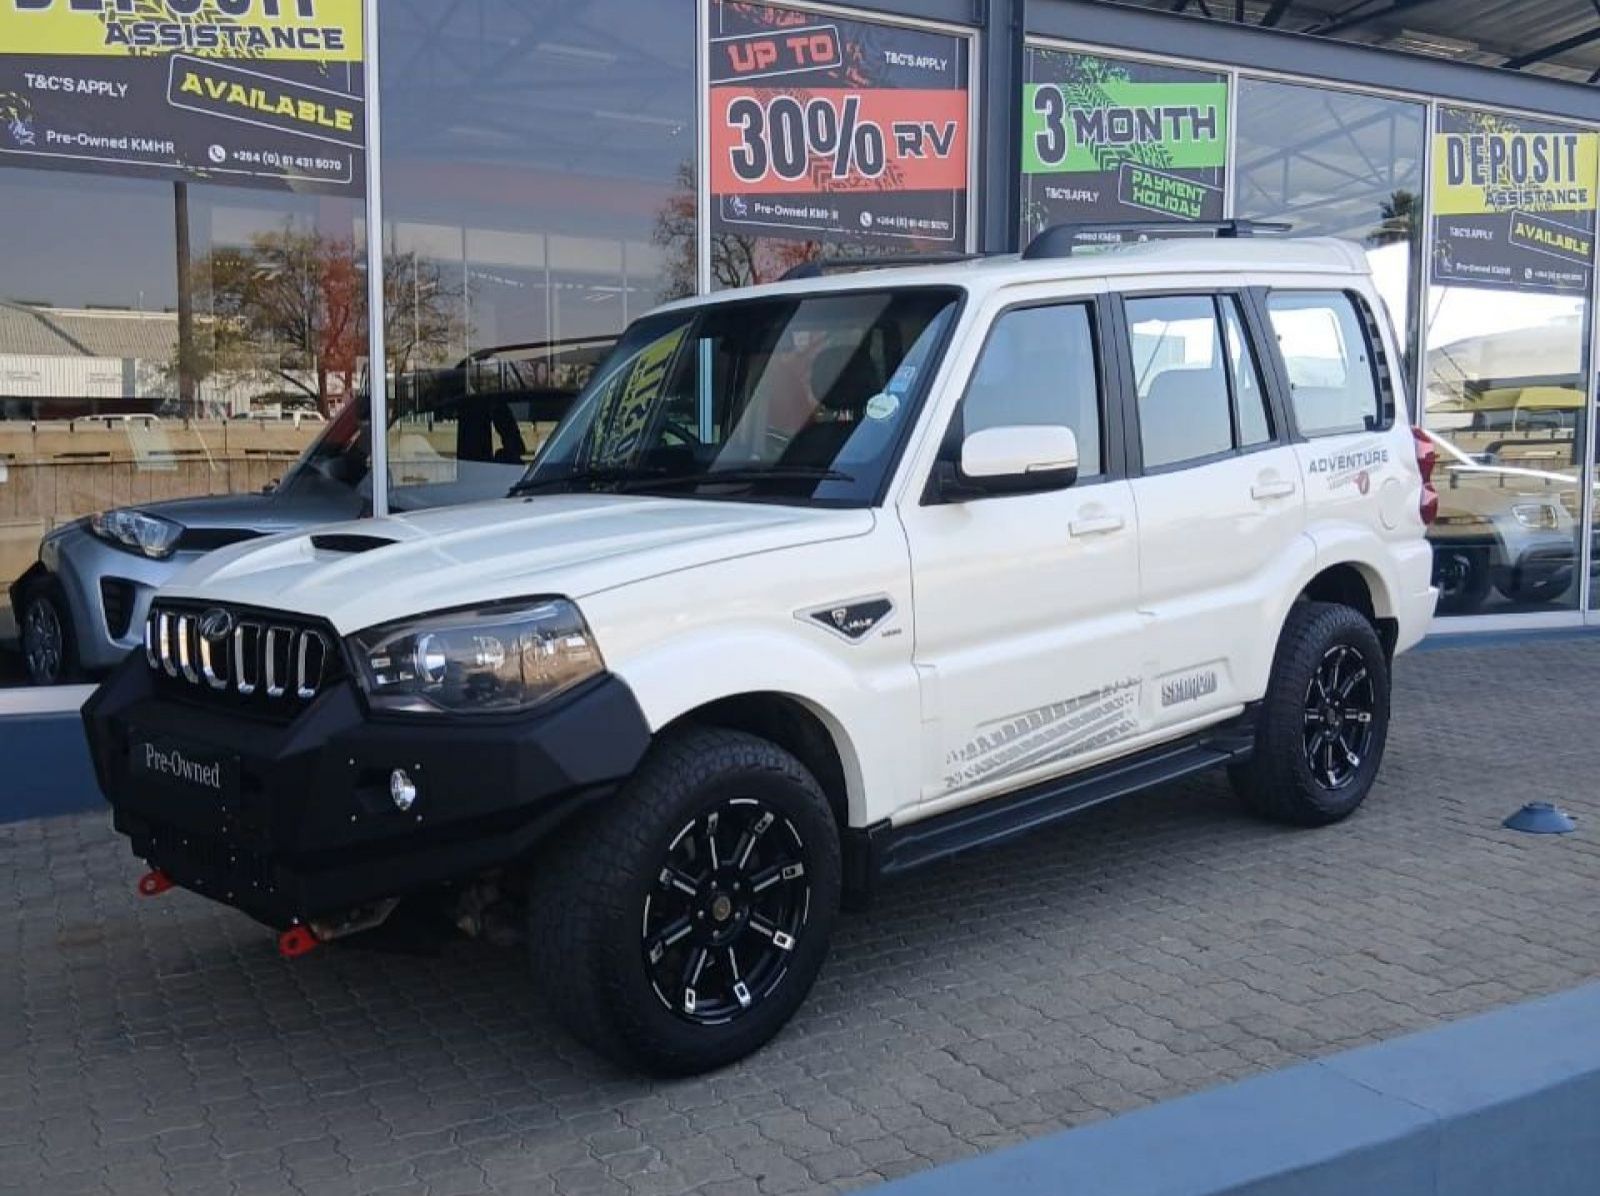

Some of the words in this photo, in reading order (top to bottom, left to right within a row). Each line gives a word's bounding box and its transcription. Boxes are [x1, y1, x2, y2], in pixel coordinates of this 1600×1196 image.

[104, 22, 346, 50] ASSISTANCE
[727, 41, 777, 73] UP
[786, 34, 835, 65] TO
[916, 56, 947, 71] APPLY
[25, 72, 74, 93] T&C'S
[76, 78, 128, 98] APPLY
[181, 73, 354, 131] AVAILABLE
[726, 95, 885, 182] 30%
[892, 121, 957, 159] RV
[1033, 83, 1066, 166] 3
[1071, 104, 1217, 146] MONTH
[46, 131, 128, 150] Pre-Owned
[130, 139, 174, 154] KMHR
[1446, 135, 1578, 186] DEPOSIT
[1131, 169, 1208, 202] PAYMENT
[1485, 188, 1588, 206] ASSISTANCE
[754, 203, 807, 218] Pre-Owned
[1133, 187, 1201, 218] HOLIDAY
[1515, 222, 1590, 255] AVAILABLE
[1309, 449, 1389, 473] ADVENTURE
[145, 743, 220, 788] Pre-Owned
